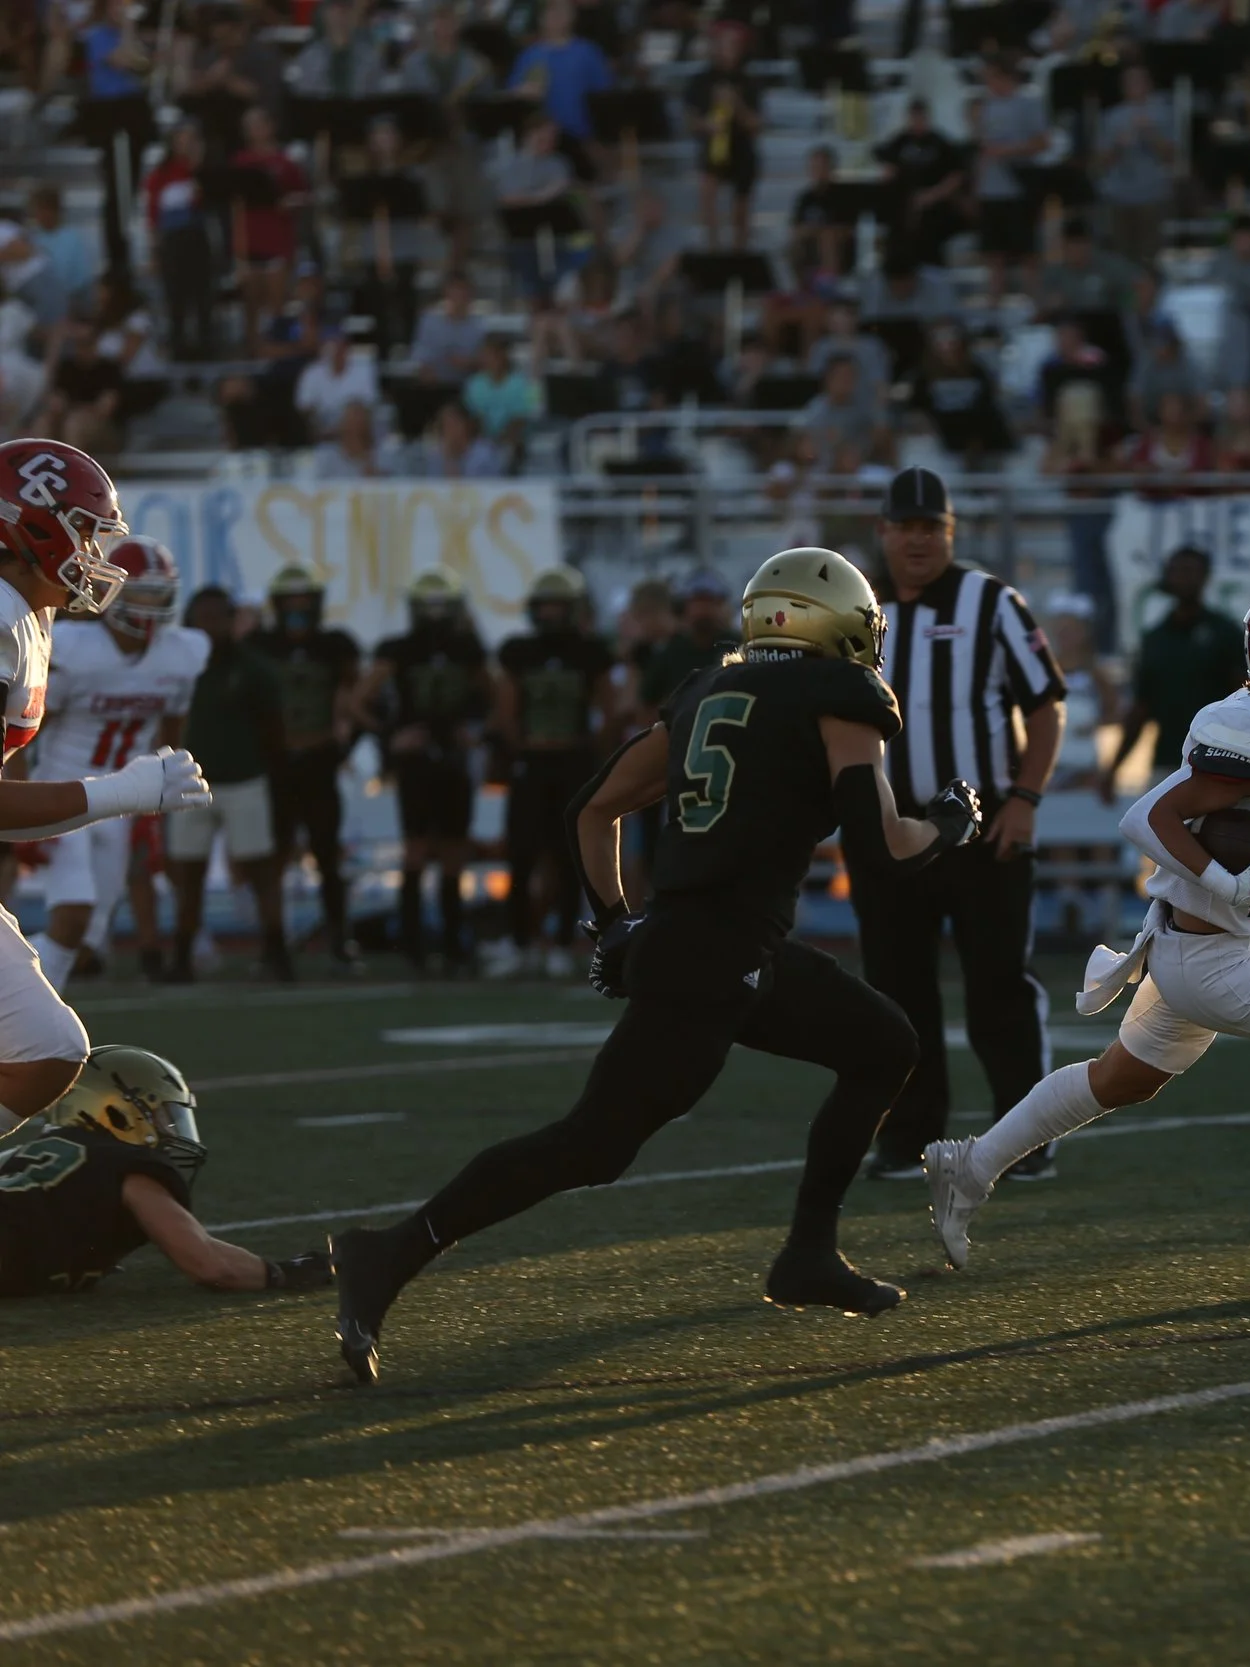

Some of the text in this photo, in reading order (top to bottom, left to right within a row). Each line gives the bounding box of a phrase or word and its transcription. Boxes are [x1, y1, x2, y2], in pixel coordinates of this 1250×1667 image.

[17, 452, 68, 507] CC
[256, 480, 537, 619] SENIORS
[91, 720, 145, 771] 11
[678, 691, 757, 832] 5
